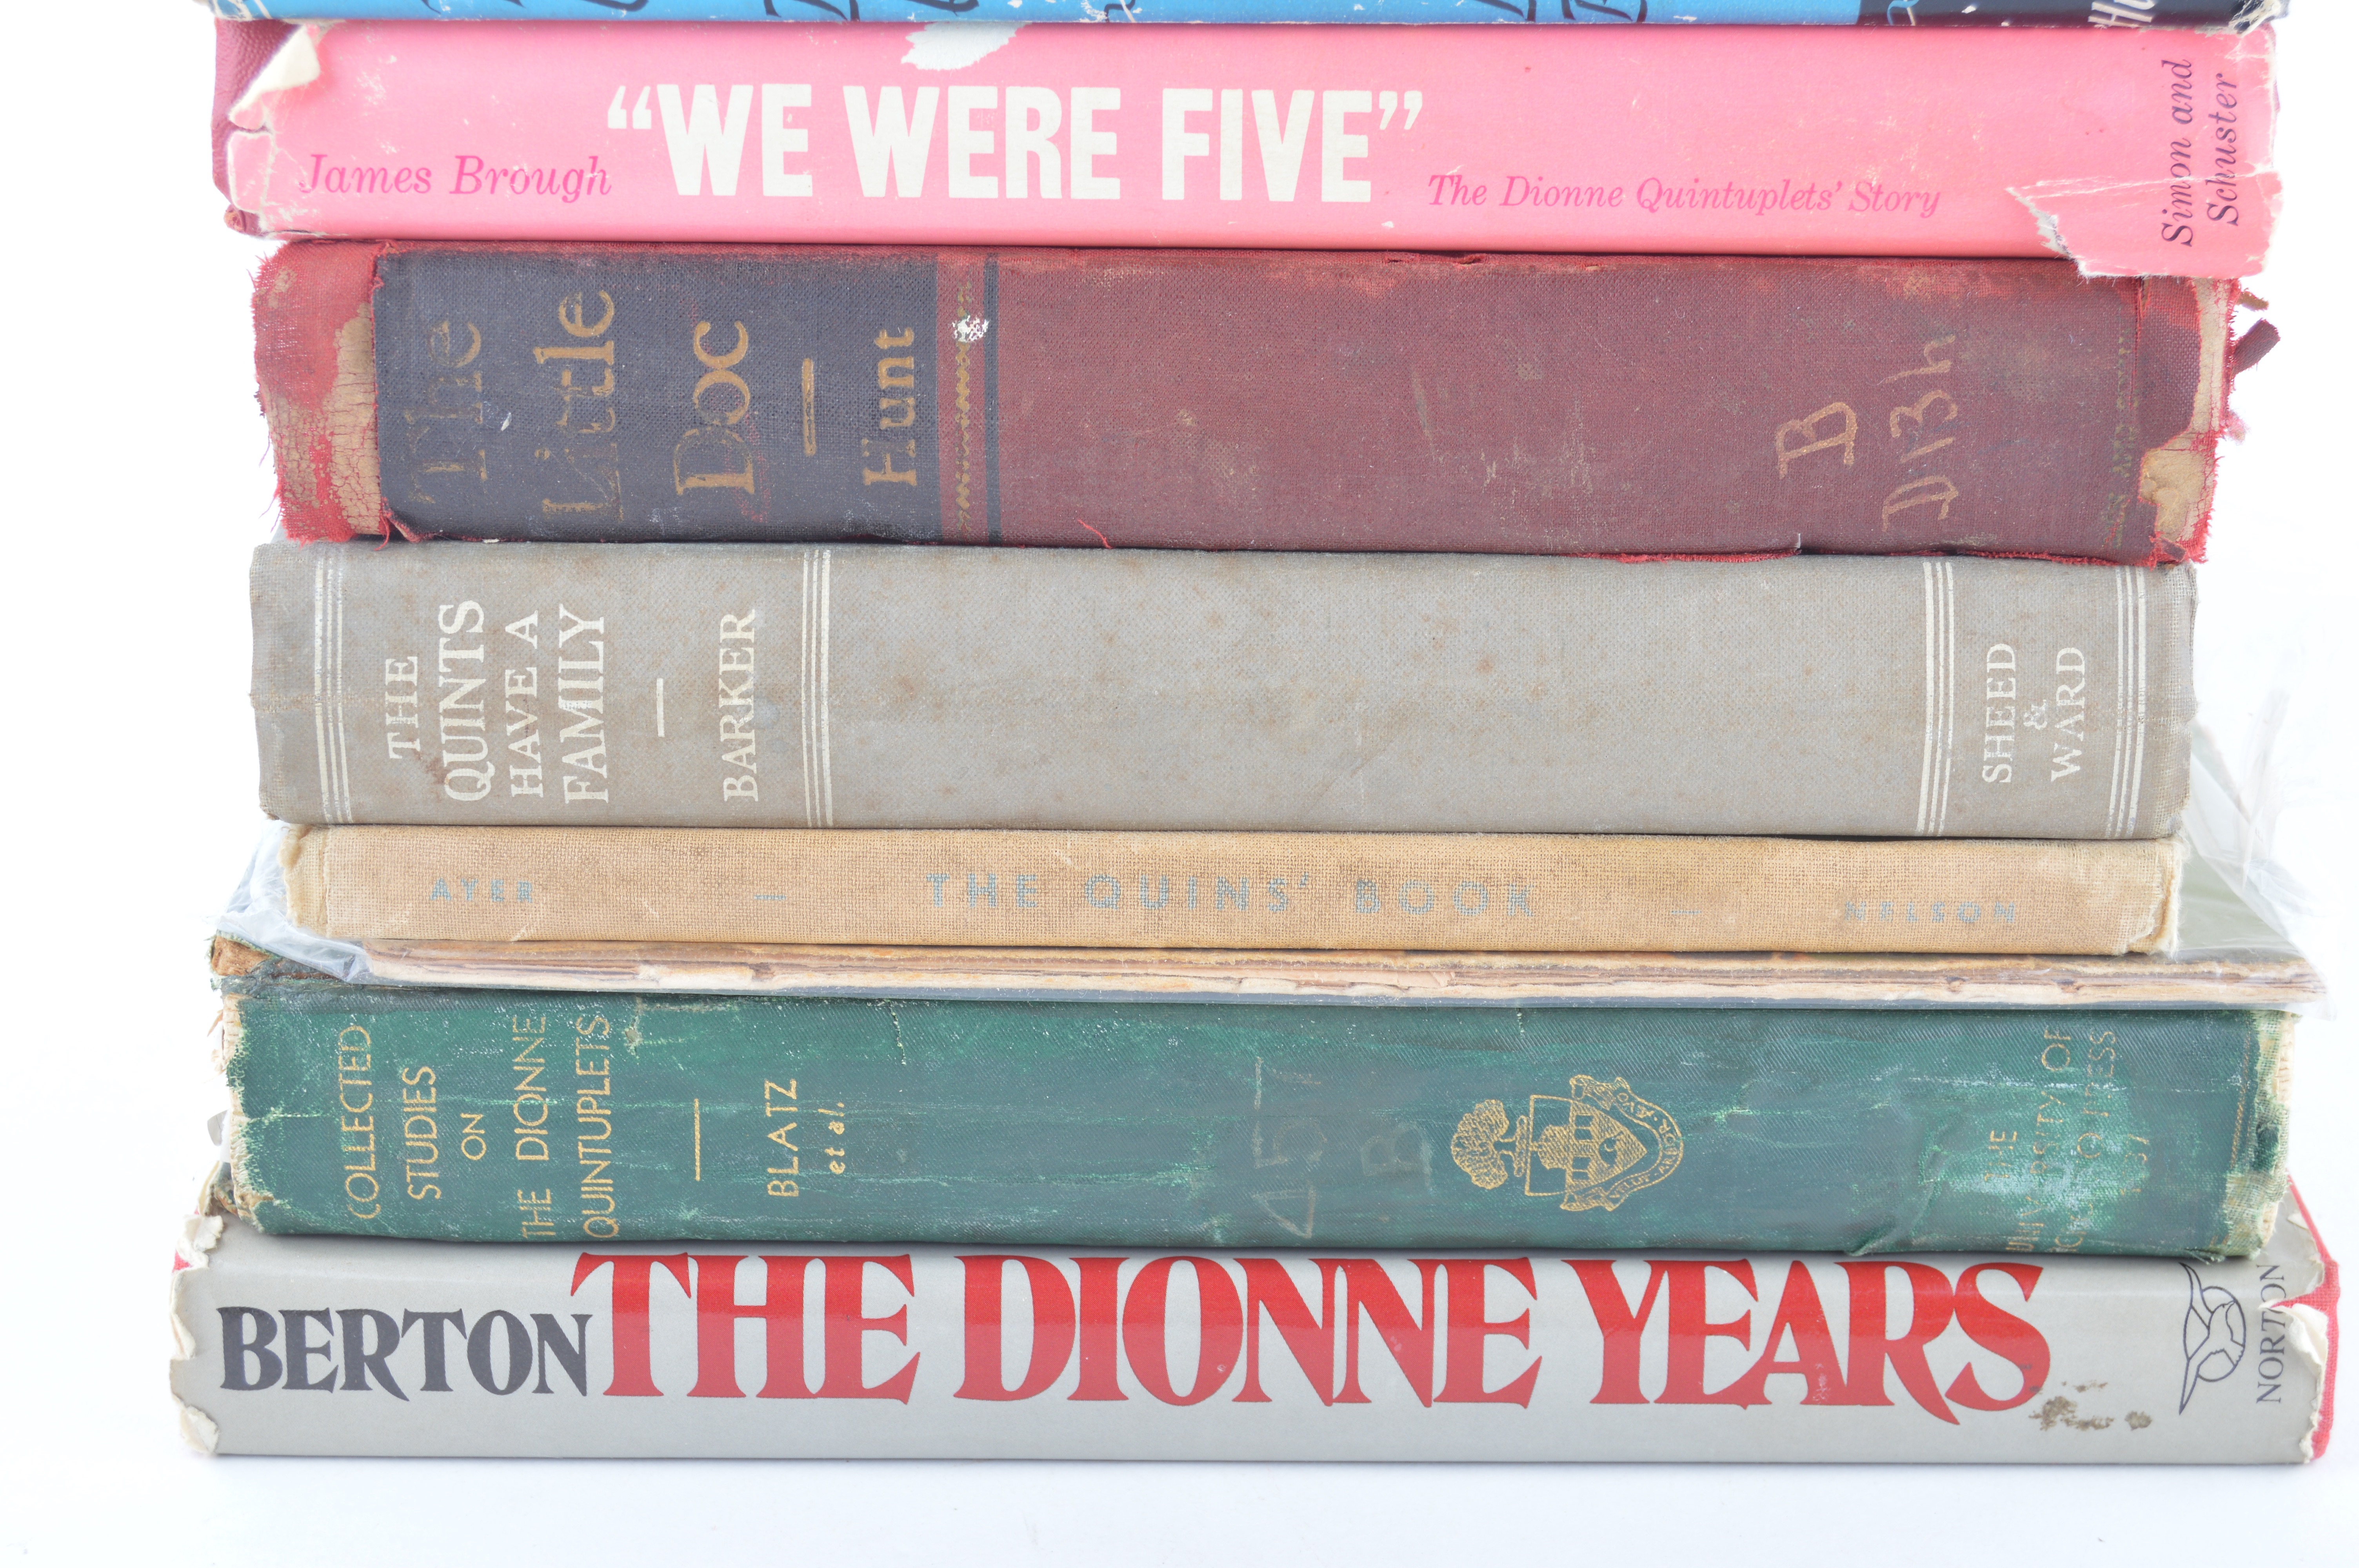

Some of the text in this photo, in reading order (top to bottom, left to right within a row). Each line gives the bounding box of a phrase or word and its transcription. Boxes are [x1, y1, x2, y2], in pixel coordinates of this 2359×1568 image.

[299, 154, 612, 202] James Brough
[843, 85, 1121, 201] WERE
[1429, 172, 1488, 209] The
[1499, 175, 1623, 209] Dionne
[1847, 180, 1941, 219] Story
[2161, 59, 2194, 248] Simon and
[2204, 73, 2239, 227] Schuster
[404, 320, 487, 503] The
[533, 290, 623, 522] Little
[673, 320, 754, 495] Doc
[863, 327, 917, 486] Hunt
[385, 655, 420, 759] THE
[437, 600, 494, 801] QUINTS
[505, 610, 543, 798] HAVE A
[559, 603, 609, 804] FAMILY
[720, 609, 758, 802] BARKER
[1982, 643, 2016, 783] SHEED
[2024, 699, 2048, 730] &
[2051, 647, 2085, 782] WARD
[430, 877, 534, 904] AYER
[926, 873, 1039, 909] THE
[1357, 880, 1535, 917] BOOK
[1844, 901, 2016, 924] NELSON
[2041, 1030, 2072, 1071] OF
[338, 1025, 380, 1220] COLLECTED
[402, 1067, 442, 1200] STUDIES
[460, 1113, 487, 1160] ON
[512, 1016, 556, 1238] THE DIONNE
[574, 1017, 619, 1238] QUINTUPLETS
[764, 1080, 800, 1196] BLATZ
[823, 1145, 846, 1174] et
[216, 1306, 591, 1402] BERTON
[571, 1252, 2051, 1425] THE DIONNE YEARS
[2256, 1265, 2286, 1404] NORTON
